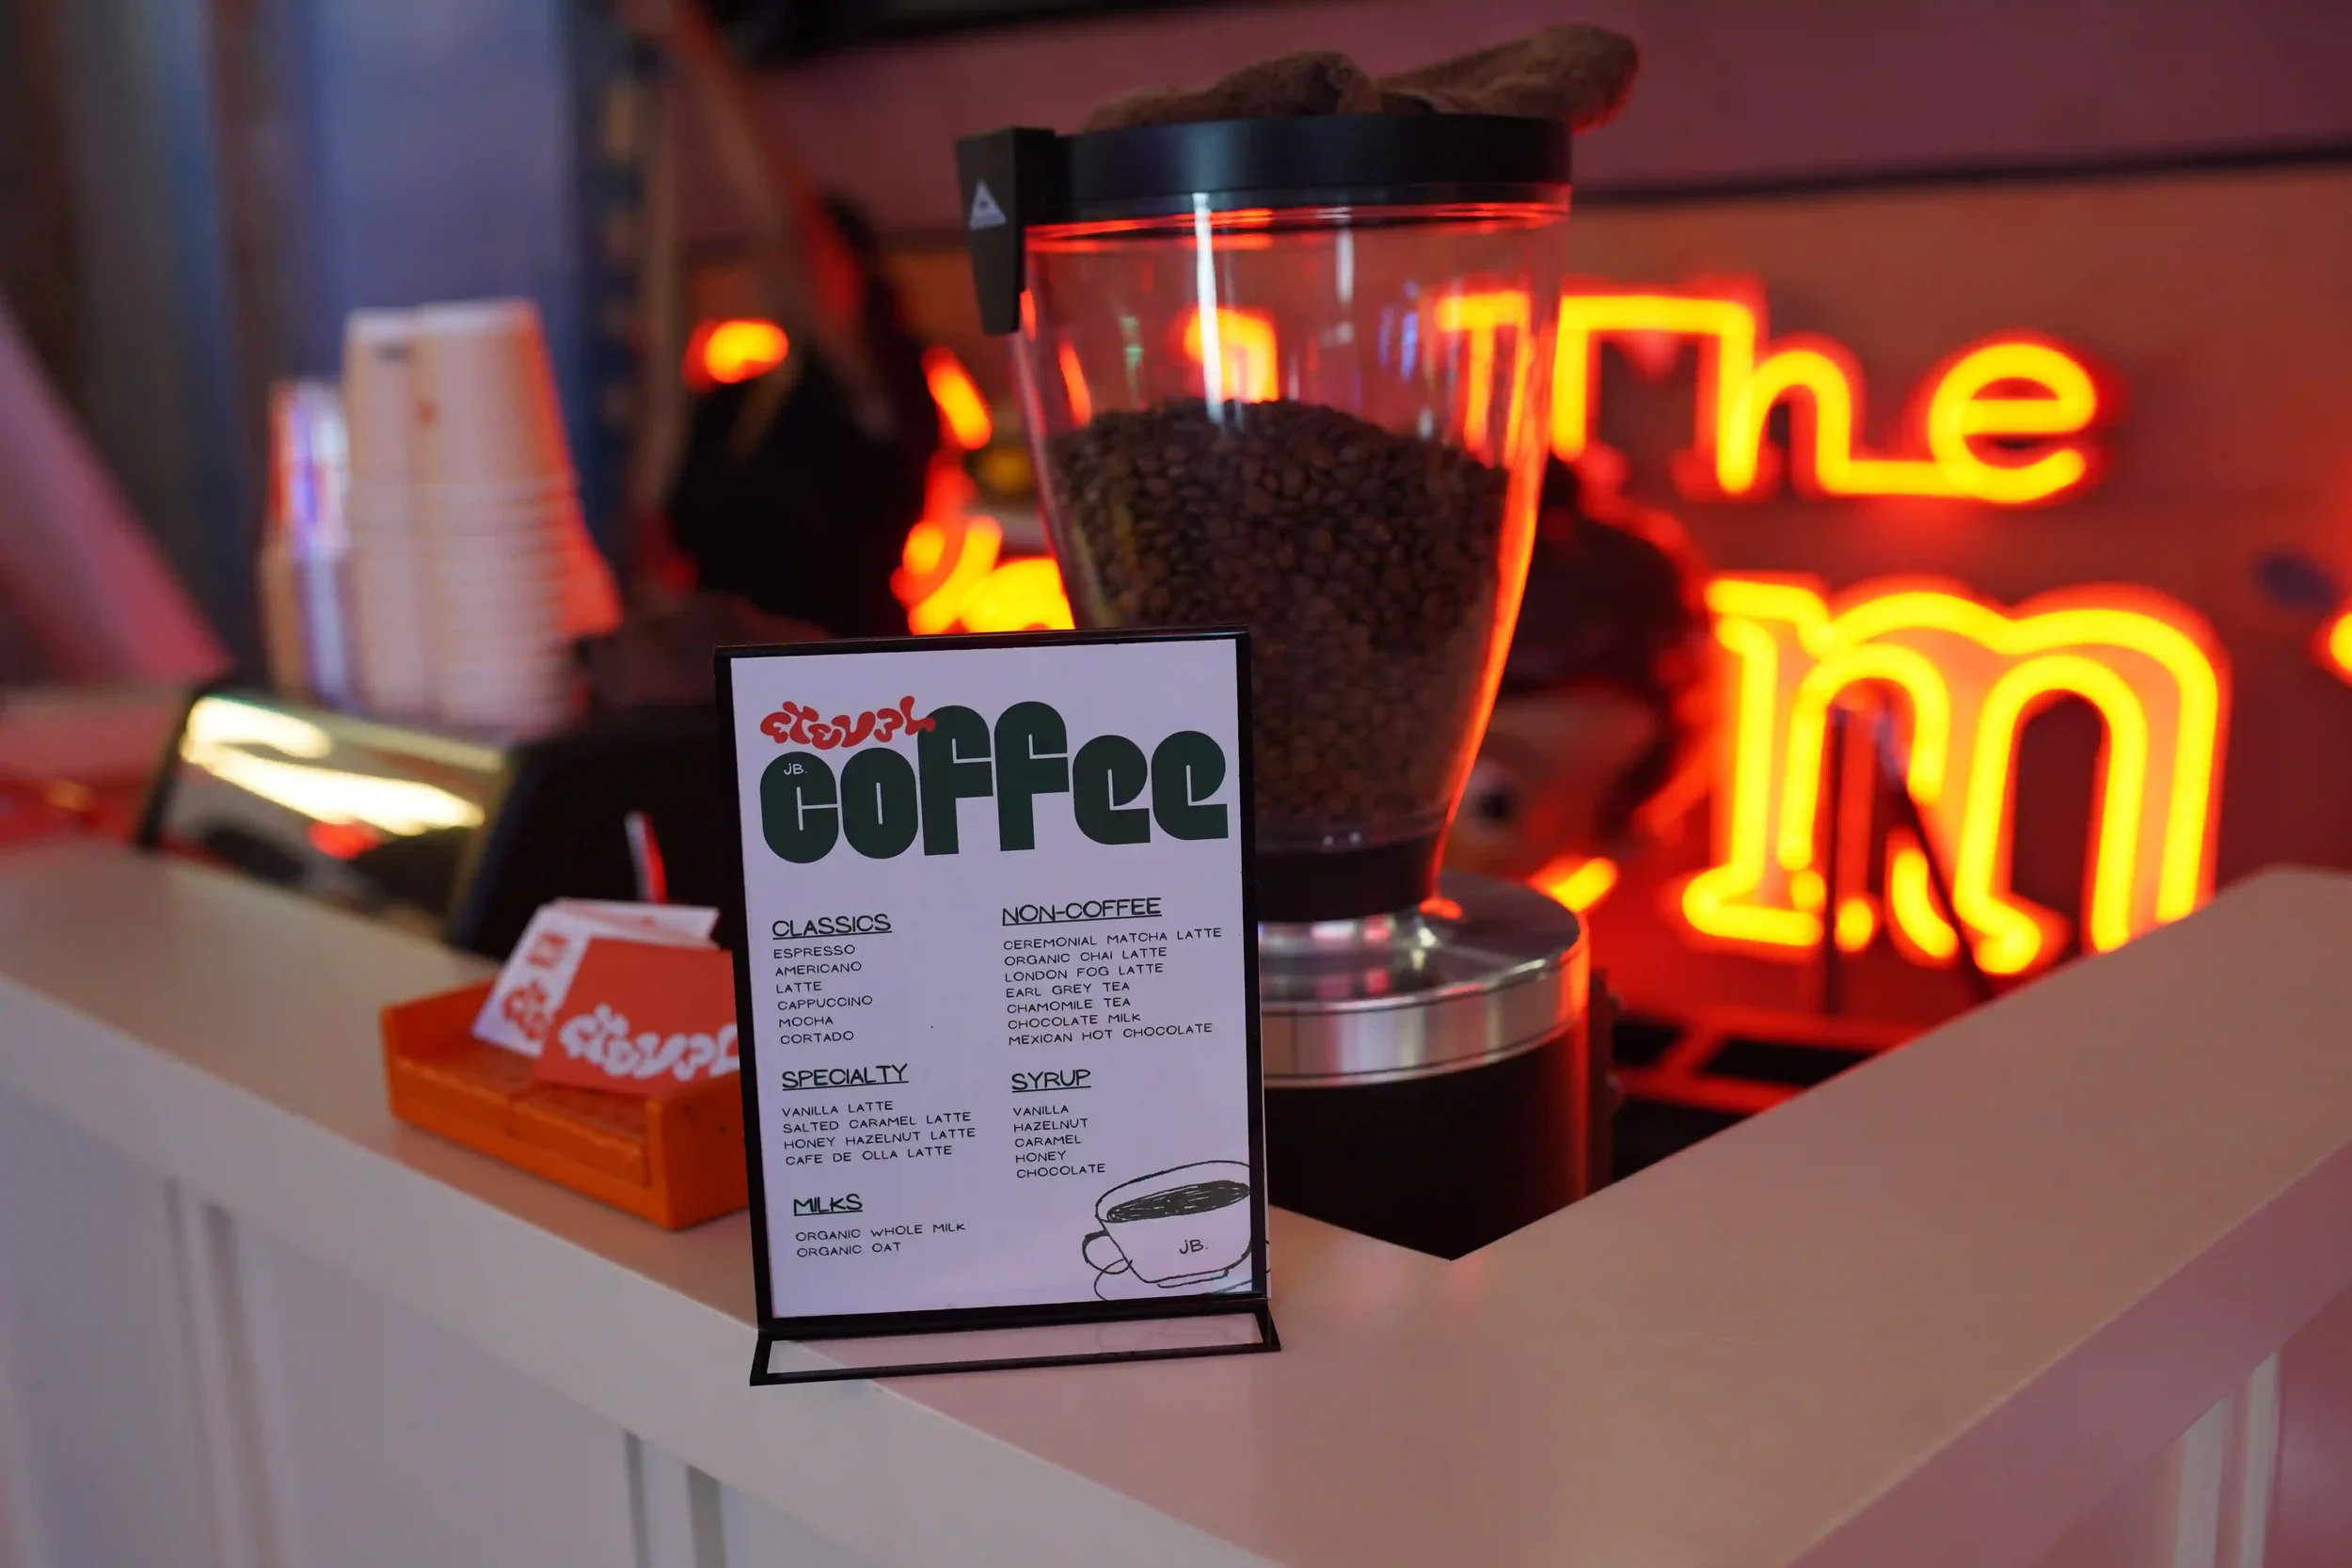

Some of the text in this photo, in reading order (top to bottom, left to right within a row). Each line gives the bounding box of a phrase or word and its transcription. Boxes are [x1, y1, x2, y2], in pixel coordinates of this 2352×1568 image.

[759, 701, 1229, 864] coffee
[1002, 897, 1162, 925] NON-COFFEE
[772, 913, 892, 939] CLASSICS
[1004, 927, 1221, 950] CEREMONIAL MATCHA LATTE
[773, 944, 855, 958] ESPRESSO
[1004, 947, 1167, 966] ORGANIC CHAI LATTE
[775, 961, 862, 976] AMERICANO
[1005, 963, 1163, 982] LONDON FOG LATTE
[776, 981, 822, 993] LATTE
[1006, 982, 1130, 998] EARL GREY TEA
[778, 995, 873, 1010] CAPPUCCINO
[1007, 997, 1131, 1013] CHAMOMILE TEA
[779, 1016, 834, 1028] MOCHA
[1008, 1013, 1141, 1029] CHOCOLATE MILK
[780, 1031, 854, 1044] CORTADO
[1009, 1023, 1213, 1046] MEXICAN HOT CHOCOLATE
[782, 1063, 909, 1089] SPECIALTY
[1011, 1069, 1091, 1091] SYRUP
[782, 1101, 894, 1117] VANILLA LATTE
[1013, 1104, 1069, 1117] VANILLA
[783, 1112, 971, 1133] SALTED CARAMEL LATTE
[1013, 1118, 1089, 1132] HAZELNUT
[784, 1128, 976, 1149] HONEY HAZELNUT LATTE
[1014, 1134, 1082, 1148] CARAMEL
[786, 1146, 952, 1165] CAFE DE OLLA LATTE
[1016, 1150, 1067, 1164] HONEY
[1016, 1164, 1106, 1179] CHOCOLATE
[793, 1194, 863, 1214] MILKS
[795, 1223, 966, 1242] ORGANIC WHOLE MILK
[797, 1243, 901, 1258] ORGANIC OAT
